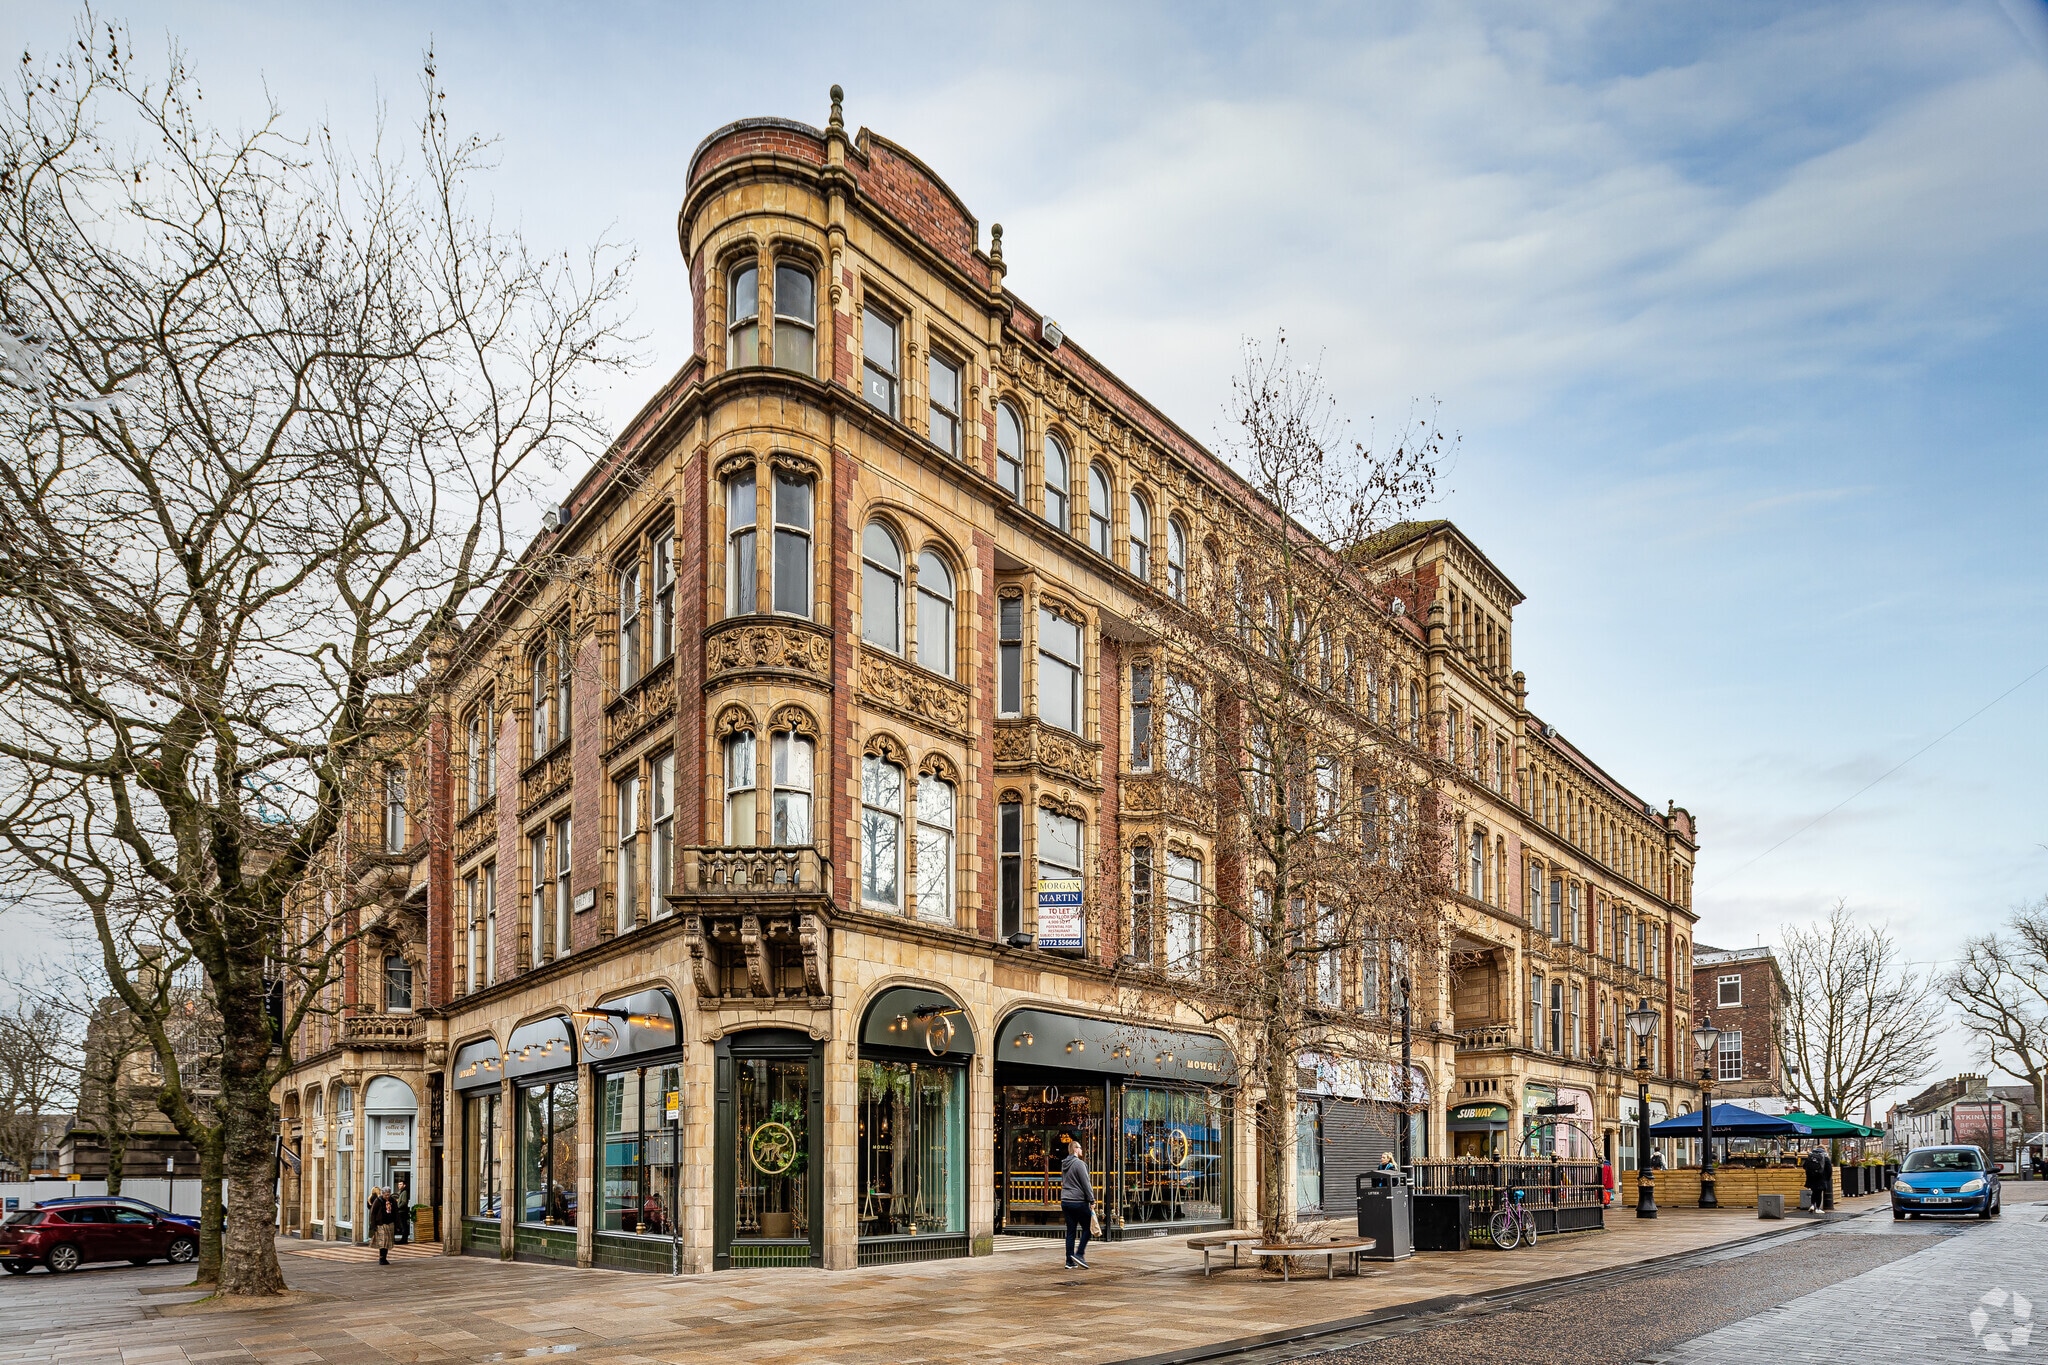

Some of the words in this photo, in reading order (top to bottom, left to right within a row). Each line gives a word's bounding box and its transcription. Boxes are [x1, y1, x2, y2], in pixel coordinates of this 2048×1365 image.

[1040, 882, 1079, 890] MORGAN
[1040, 893, 1079, 902] MARTIN
[1457, 1107, 1497, 1119] SUBWAY
